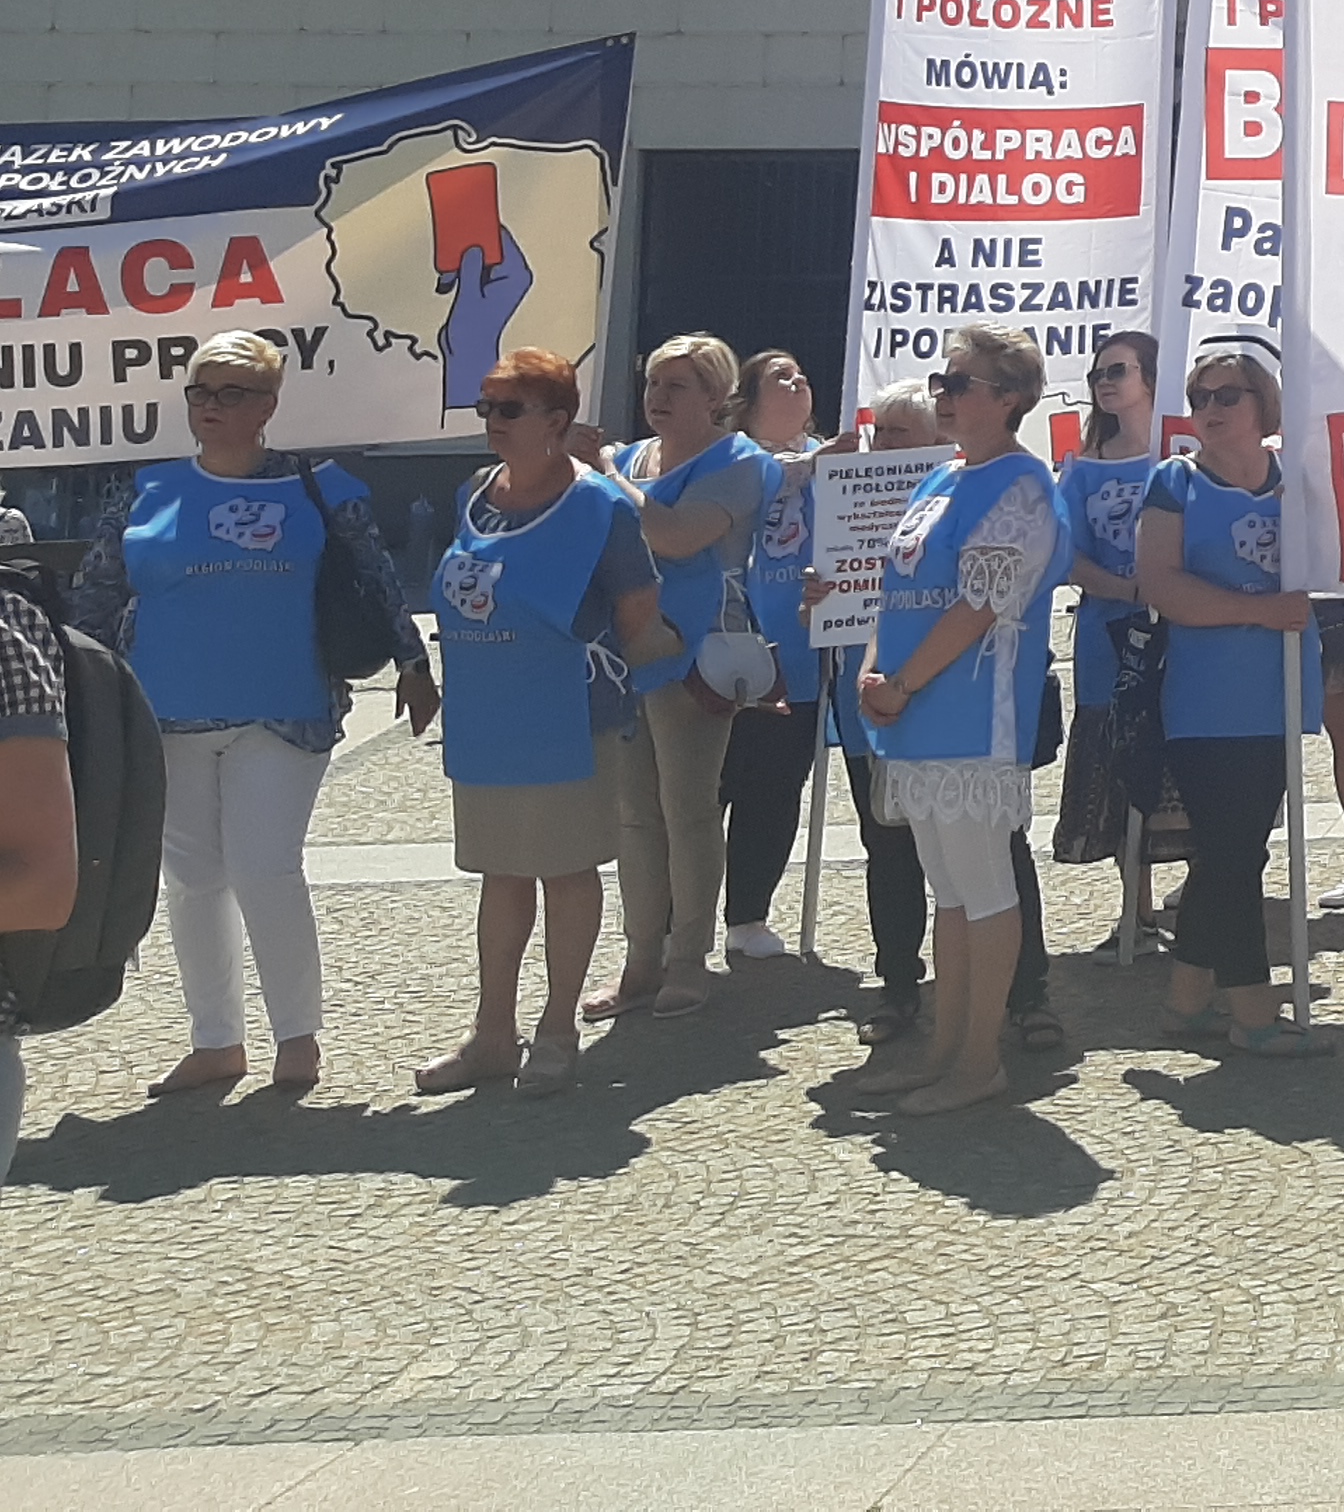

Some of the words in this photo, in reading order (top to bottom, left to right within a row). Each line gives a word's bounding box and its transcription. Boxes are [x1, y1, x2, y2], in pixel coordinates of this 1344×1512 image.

[925, 54, 1068, 96] MÓWIĄ:
[1224, 69, 1283, 159] B
[0, 142, 100, 169] ĄZEK
[101, 113, 345, 160] ZAWODOWY
[876, 122, 1137, 161] WSPÓŁPRACA
[0, 153, 228, 190] POŁOŻNYCH
[910, 172, 918, 203] I
[931, 171, 1086, 205] DIALOG
[2, 192, 100, 221] LASKI
[1221, 205, 1282, 256] Pa
[935, 239, 956, 268] A
[971, 237, 1044, 268] NIE
[0, 235, 285, 318] ACA
[863, 276, 1139, 313] ZASTRASZANIE
[873, 327, 882, 358] I
[0, 341, 83, 388] IU
[0, 401, 160, 451] ANIU
[828, 462, 940, 480] PIELĘGNIARK
[853, 480, 922, 494] POŁOŻN
[835, 555, 886, 573] ZOST
